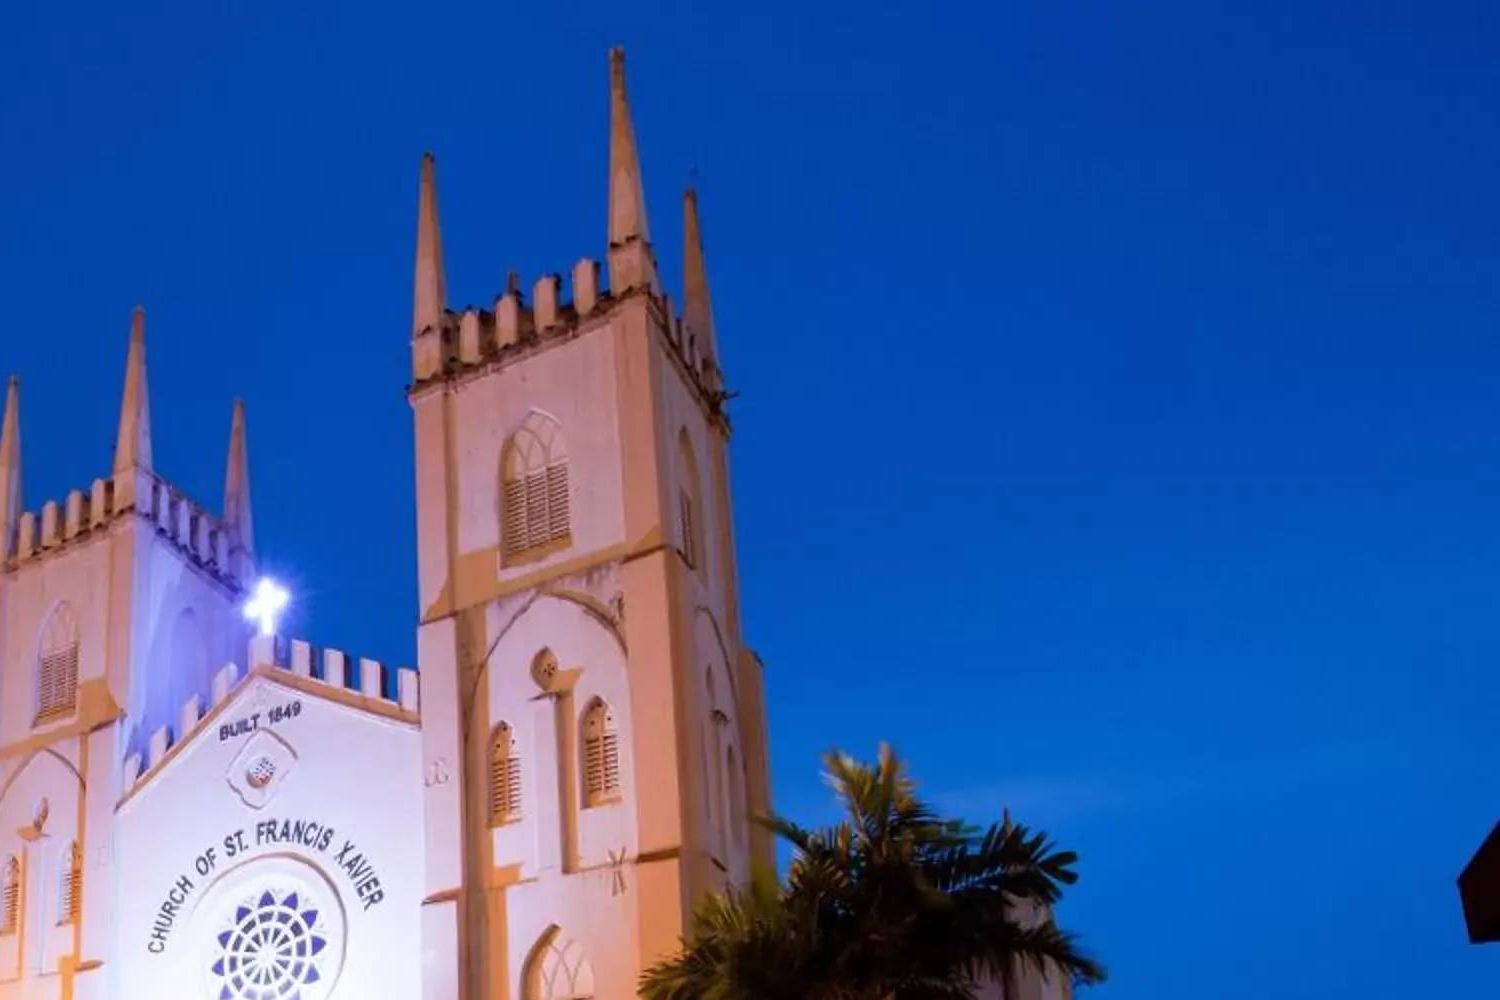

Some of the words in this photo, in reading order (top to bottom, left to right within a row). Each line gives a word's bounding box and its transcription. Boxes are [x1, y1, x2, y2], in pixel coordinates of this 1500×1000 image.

[220, 713, 260, 741] BUILT
[268, 701, 301, 725] 1849
[148, 875, 194, 953] CHURCH
[195, 847, 217, 876] OF
[224, 829, 249, 857] ST.
[256, 818, 334, 851] FRANCIS
[334, 840, 384, 911] XAVIER
